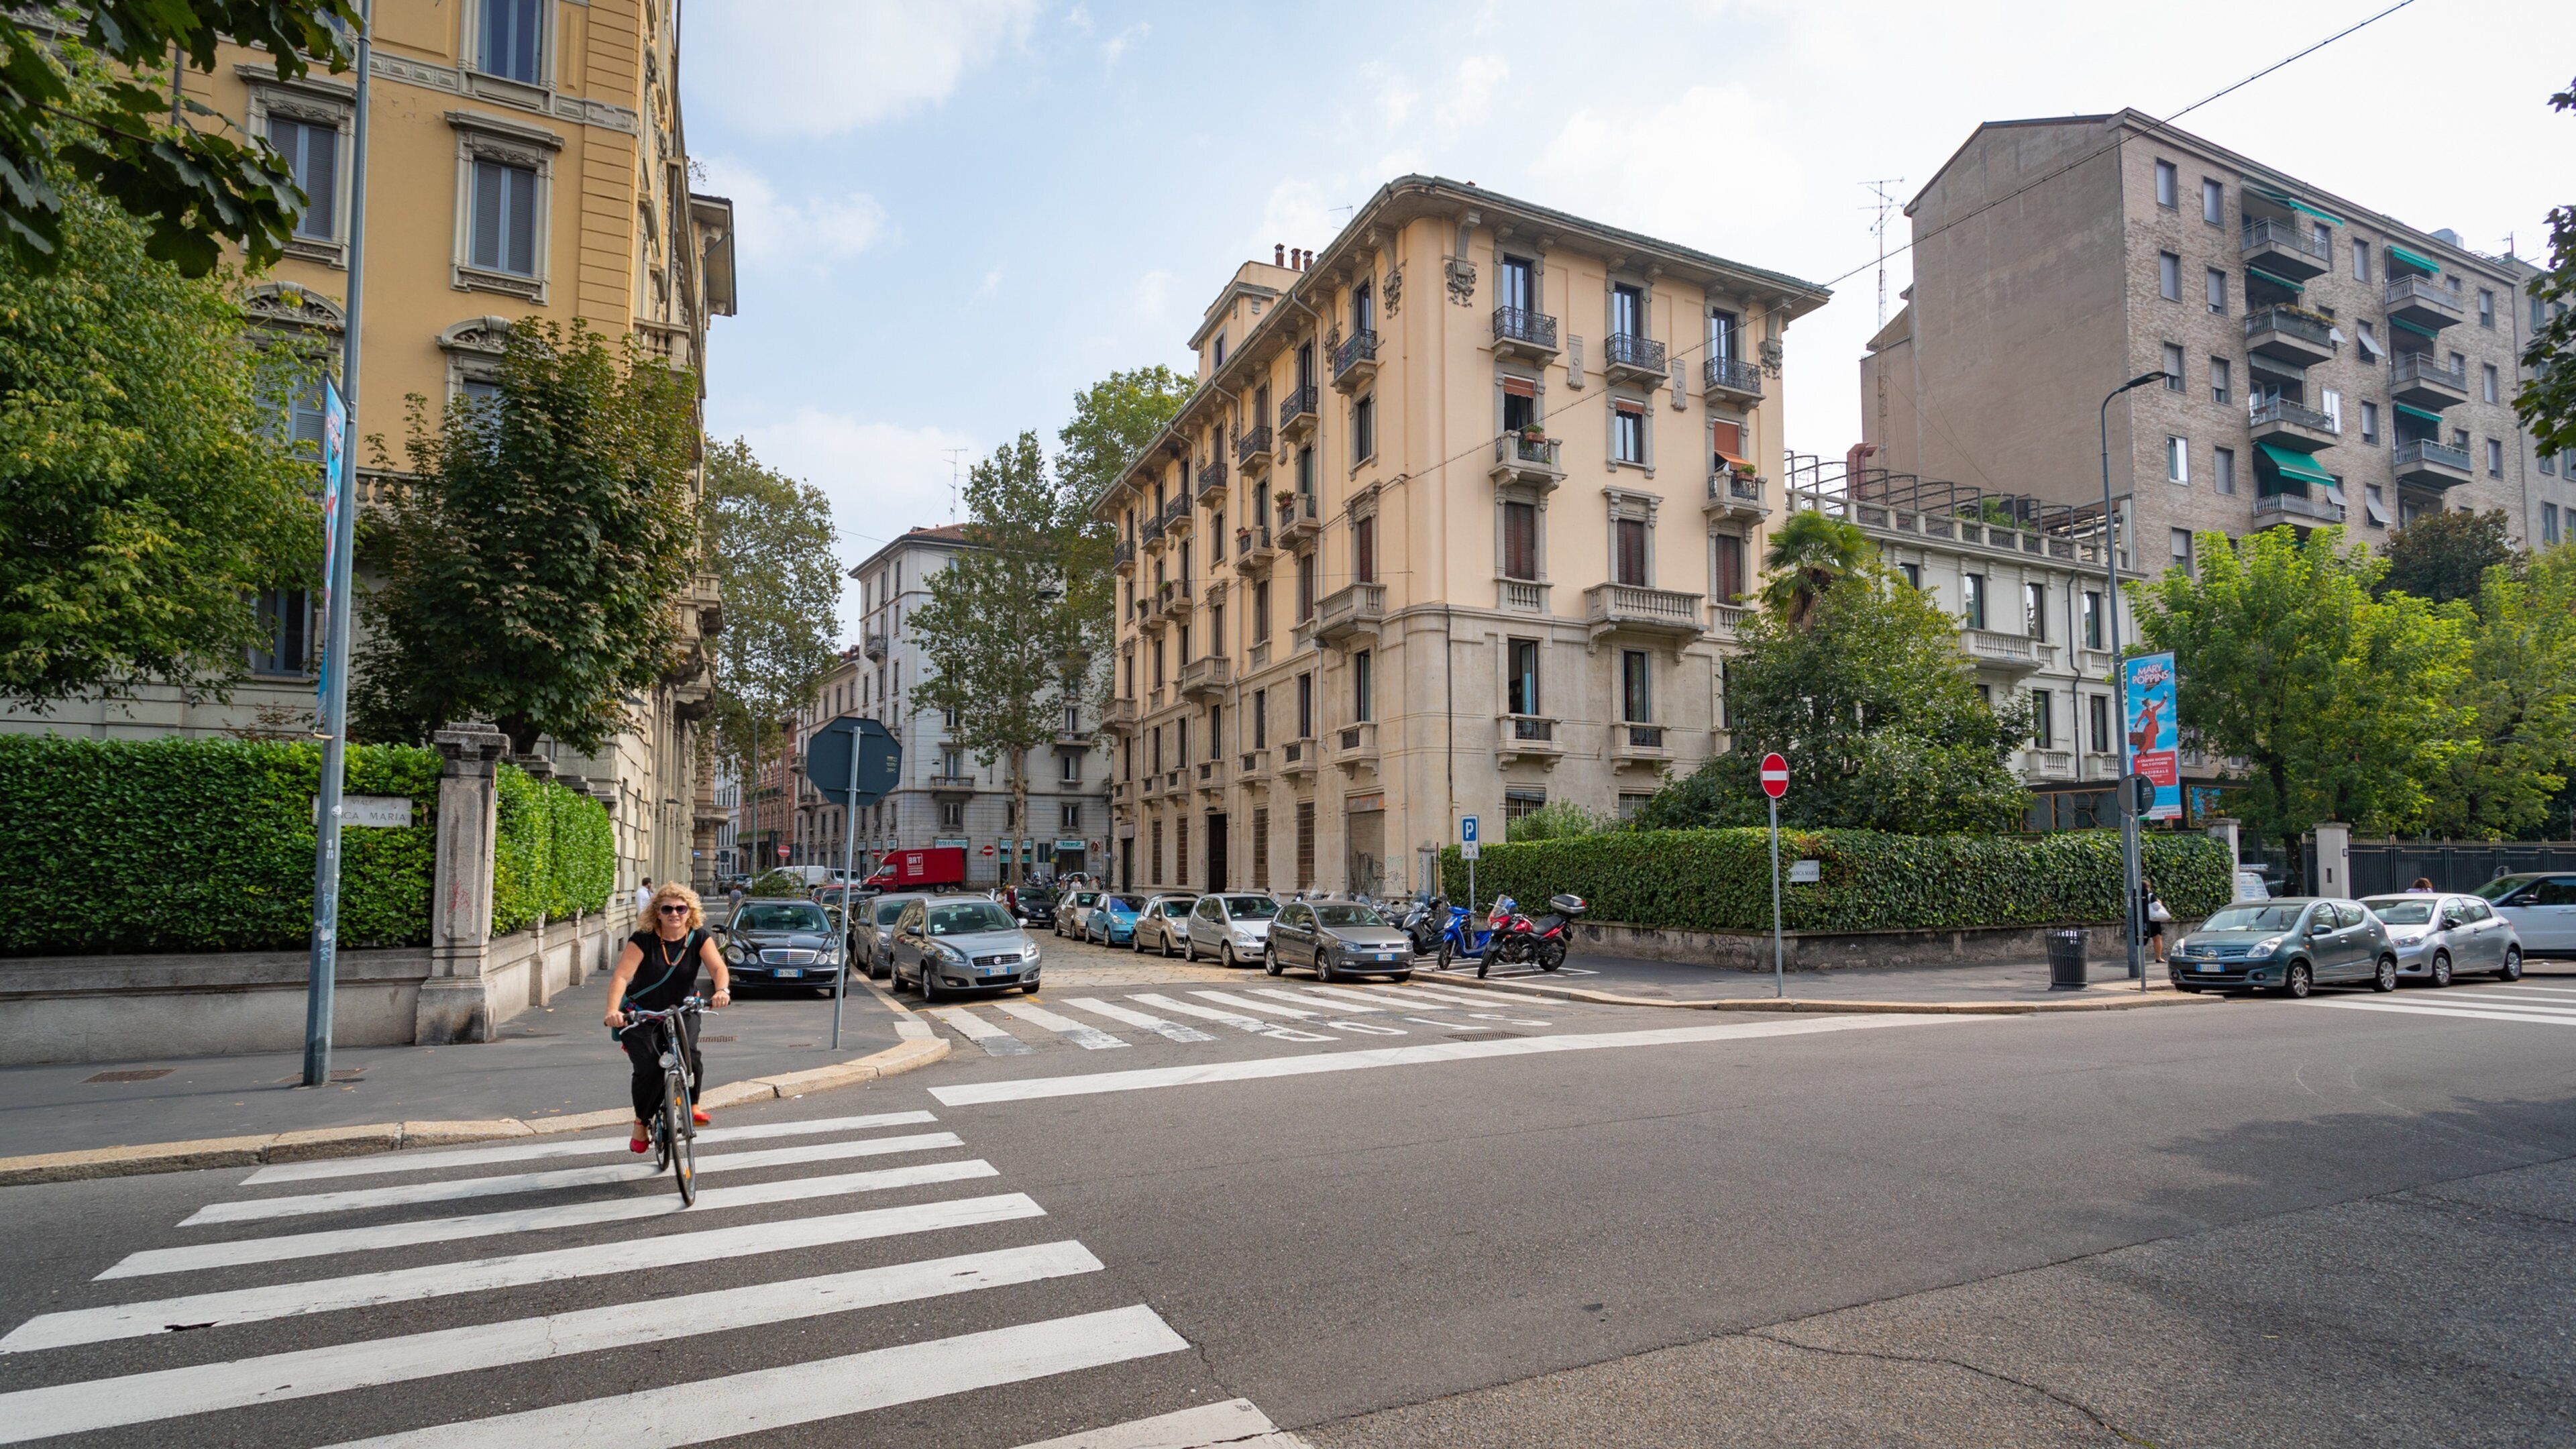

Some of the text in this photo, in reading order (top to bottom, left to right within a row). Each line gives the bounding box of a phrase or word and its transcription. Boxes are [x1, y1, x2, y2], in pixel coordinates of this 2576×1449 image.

[2132, 669, 2169, 684] POPPINS
[2137, 663, 2163, 676] MARY
[370, 812, 406, 821] MARIA
[1466, 822, 1474, 839] P
